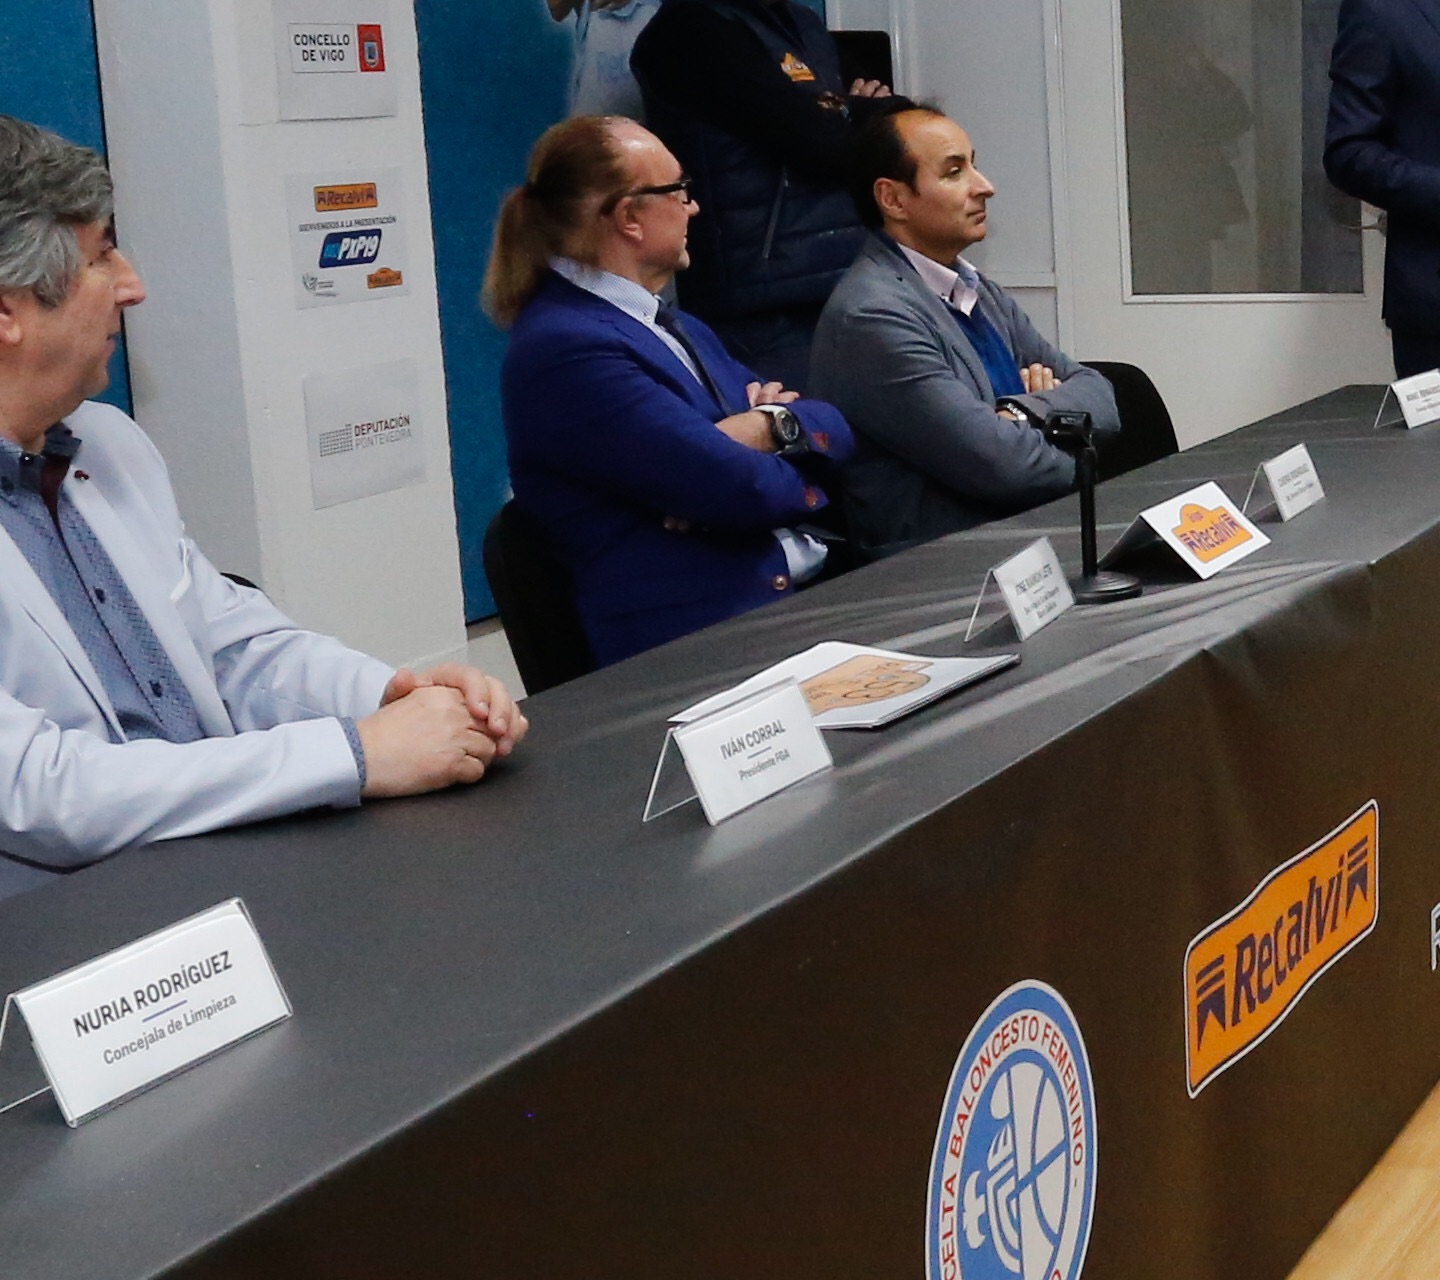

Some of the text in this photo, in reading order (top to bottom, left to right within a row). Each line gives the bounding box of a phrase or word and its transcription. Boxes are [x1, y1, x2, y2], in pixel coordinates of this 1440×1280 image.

[294, 34, 350, 46] CONCELLO
[302, 50, 345, 61] DE VIGO
[337, 236, 379, 260] PXP19
[354, 413, 410, 437] DEPUTACIÓN
[720, 720, 786, 760] IVÁN CORRAL
[739, 750, 790, 781] Presidente FGA
[1231, 854, 1345, 1027] Recalvi
[73, 950, 233, 1038] NURIA RODRÍGUEZ
[103, 993, 237, 1065] Concejala de Limpieza
[949, 1014, 1039, 1160] BALONCESTO
[1040, 1022, 1085, 1167] FEMENINO
